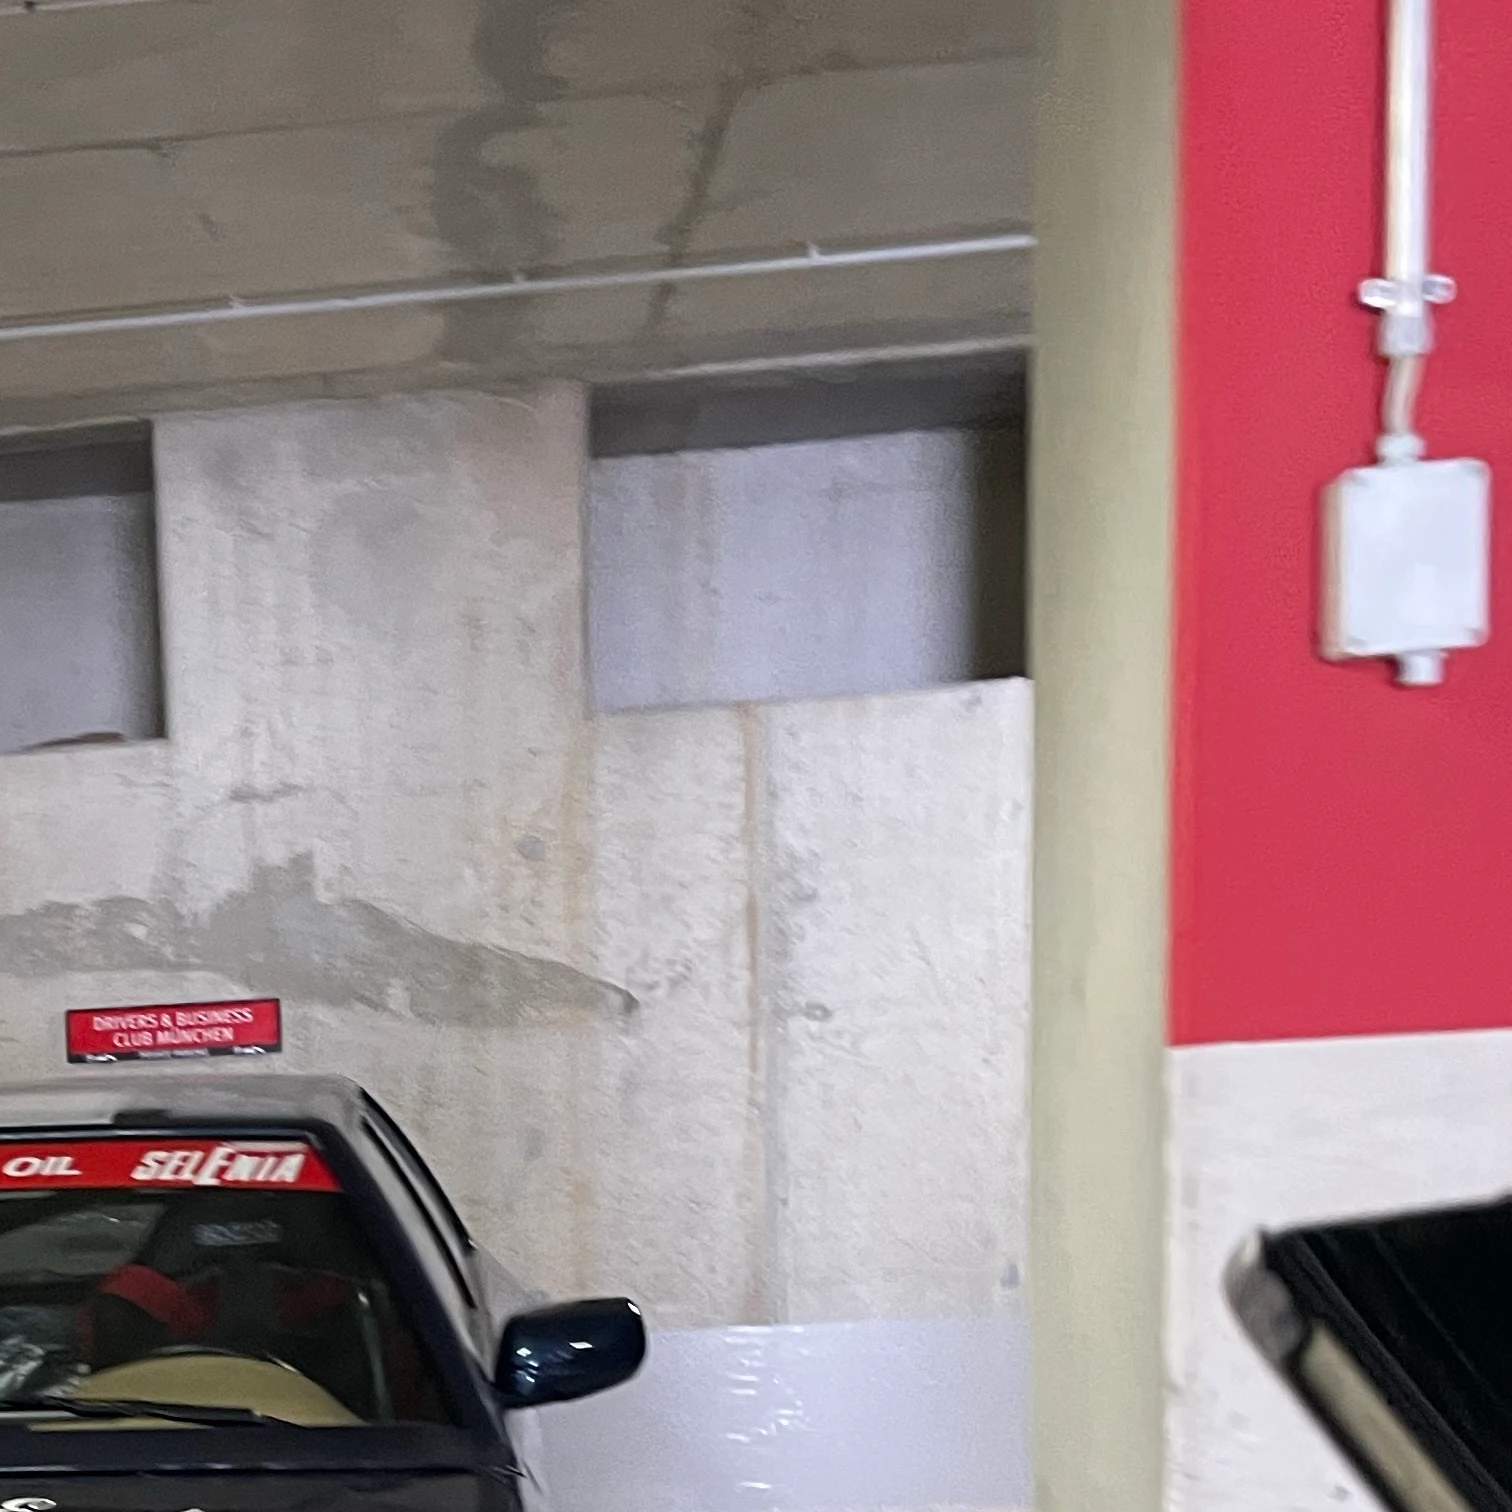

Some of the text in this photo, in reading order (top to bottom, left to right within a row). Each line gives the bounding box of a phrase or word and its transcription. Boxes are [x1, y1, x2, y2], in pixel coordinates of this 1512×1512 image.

[92, 1007, 254, 1031] DRIVERS & BUSINESS
[112, 1026, 235, 1047] CLUB MÜNCHEN
[1, 1156, 82, 1177] OIL
